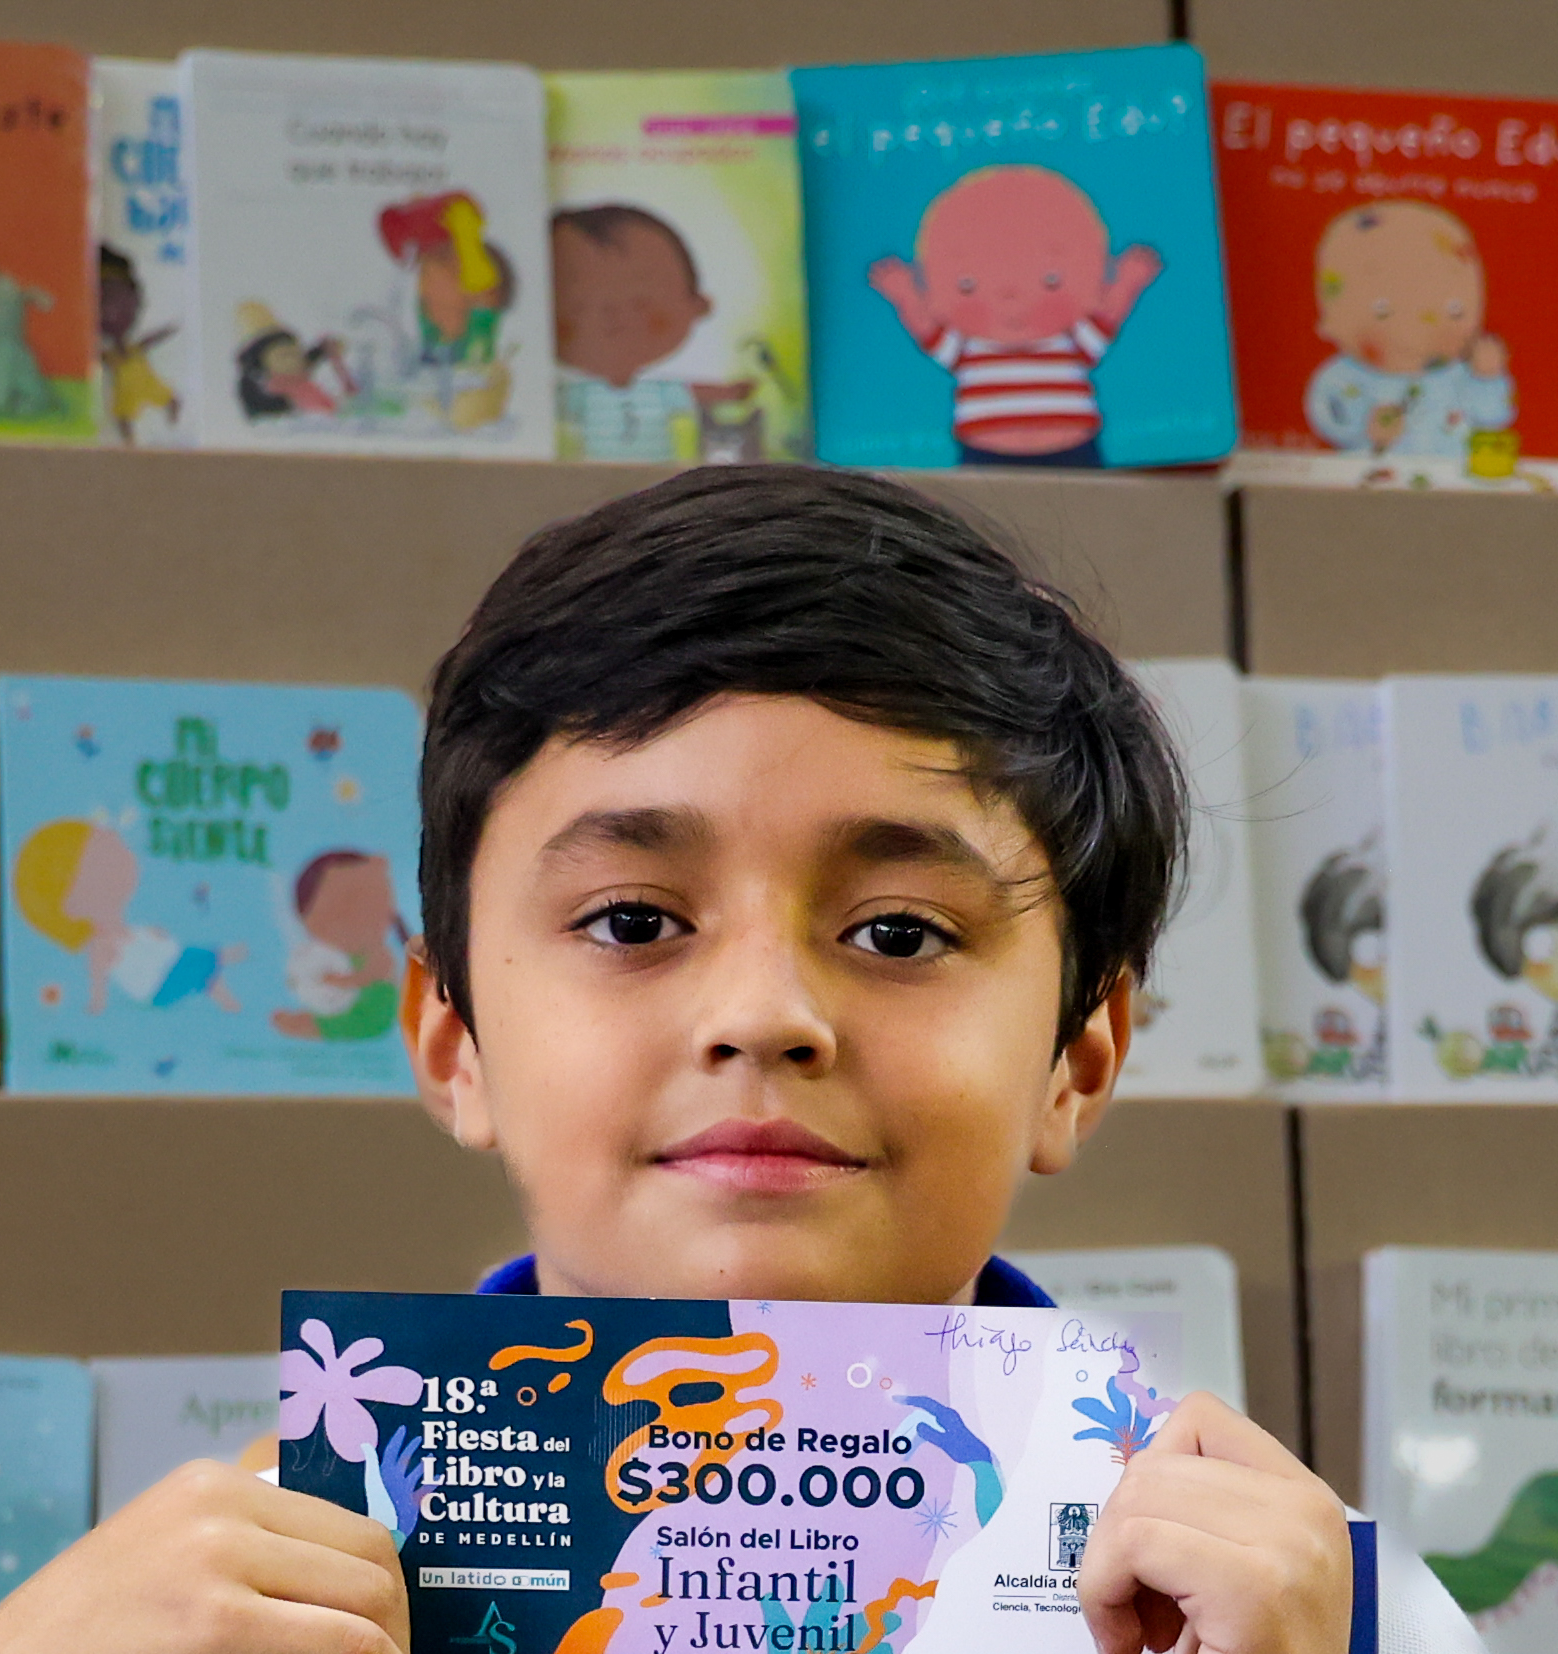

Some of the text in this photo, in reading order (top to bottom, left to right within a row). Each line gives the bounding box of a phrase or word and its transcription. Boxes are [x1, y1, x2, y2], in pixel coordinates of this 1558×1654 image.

[1222, 101, 1272, 150] El
[1286, 113, 1482, 168] pequeño
[421, 1421, 570, 1453] Fiesta del
[649, 1424, 912, 1457] Bono de Regalo
[421, 1456, 566, 1490] Libro y la
[617, 1457, 925, 1509] $300.000
[420, 1493, 571, 1525] Cultura
[419, 1529, 572, 1547] DE MEDELLÍN
[656, 1524, 859, 1552] Salón del Libro
[422, 1572, 443, 1585] Un
[451, 1572, 507, 1586] latido
[657, 1556, 857, 1604] Infantil
[994, 1574, 1057, 1589] Alcaldía
[690, 1611, 857, 1652] Juvenil
